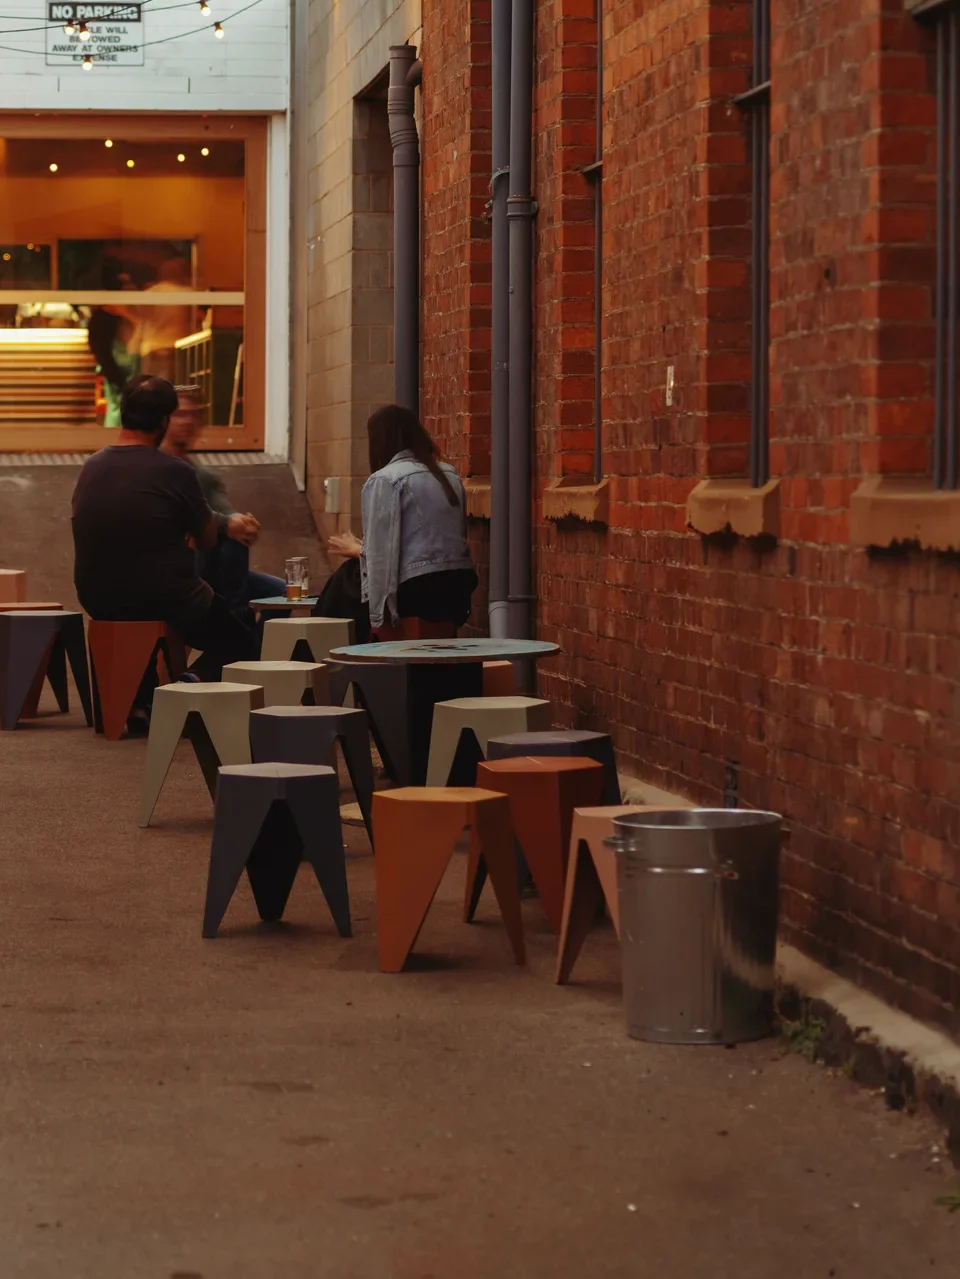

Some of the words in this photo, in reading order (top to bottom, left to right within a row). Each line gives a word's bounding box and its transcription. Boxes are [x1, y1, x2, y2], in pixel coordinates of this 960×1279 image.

[52, 5, 73, 19] NO
[76, 5, 138, 19] PARKING
[106, 26, 128, 34] WILL
